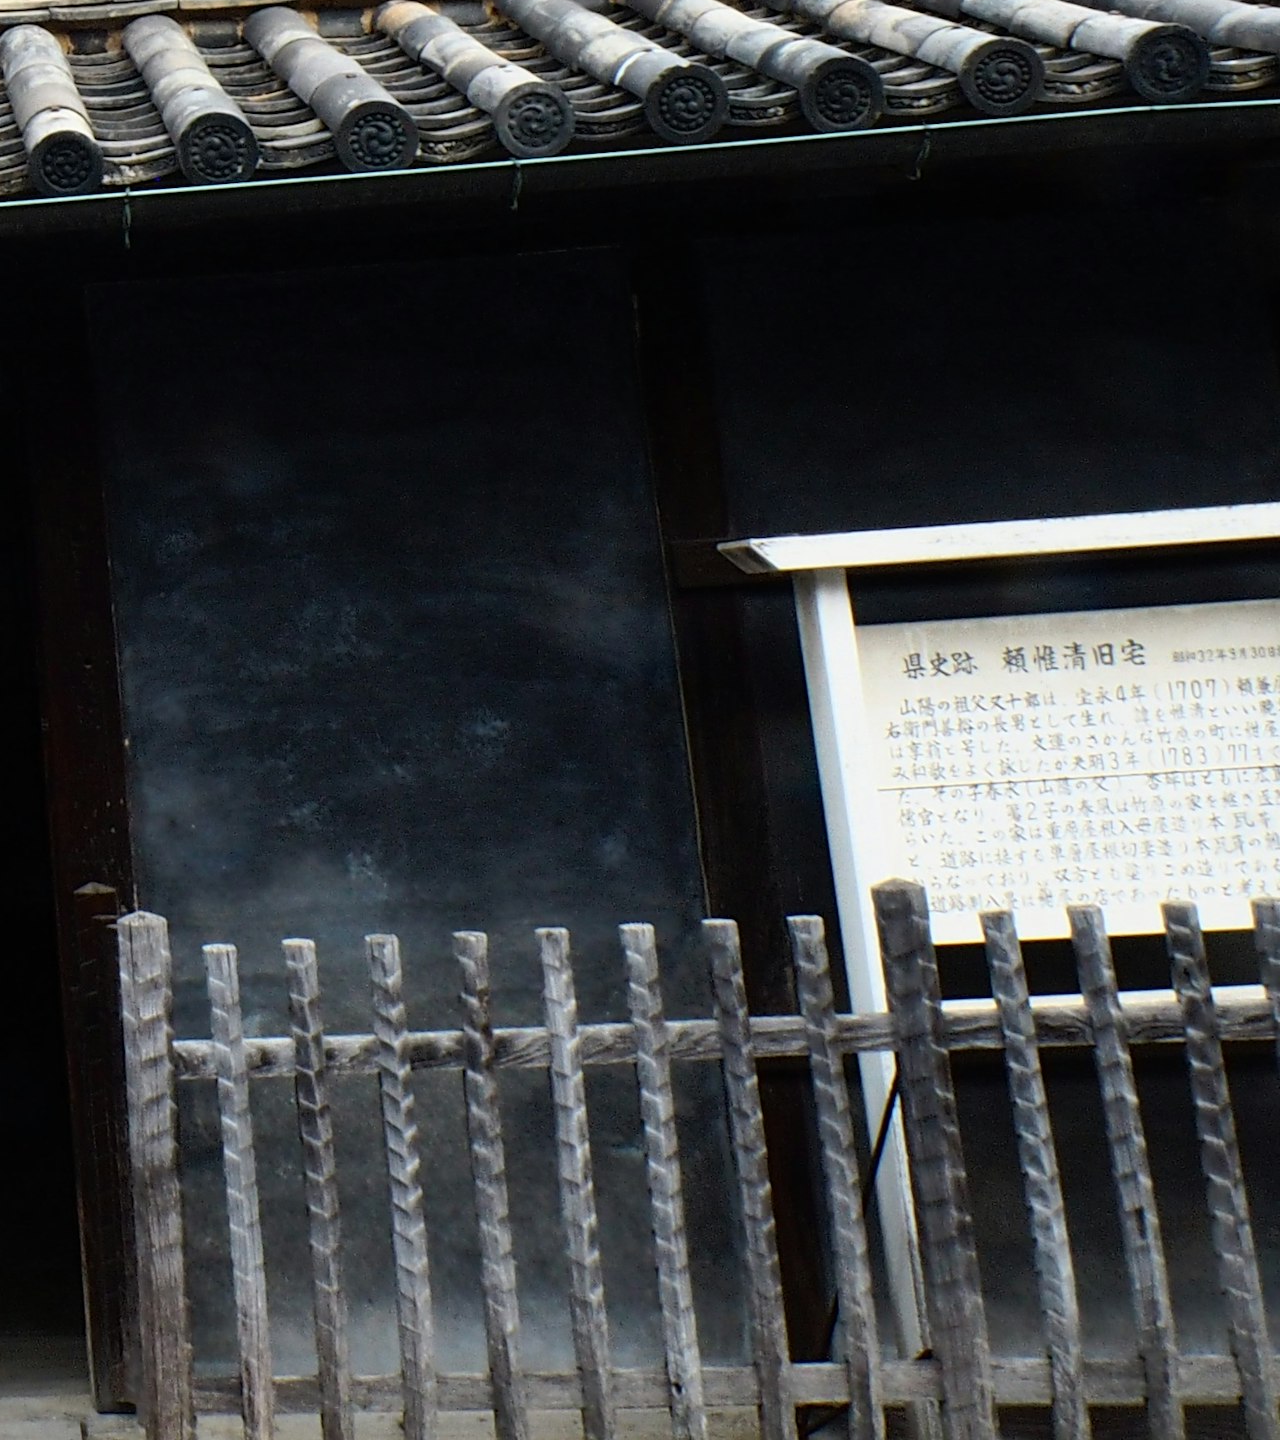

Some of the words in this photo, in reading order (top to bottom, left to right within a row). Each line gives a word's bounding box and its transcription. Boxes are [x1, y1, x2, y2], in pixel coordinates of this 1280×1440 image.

[902, 651, 979, 680] 県史跡
[1001, 639, 1146, 674] 頼惟清旧宅
